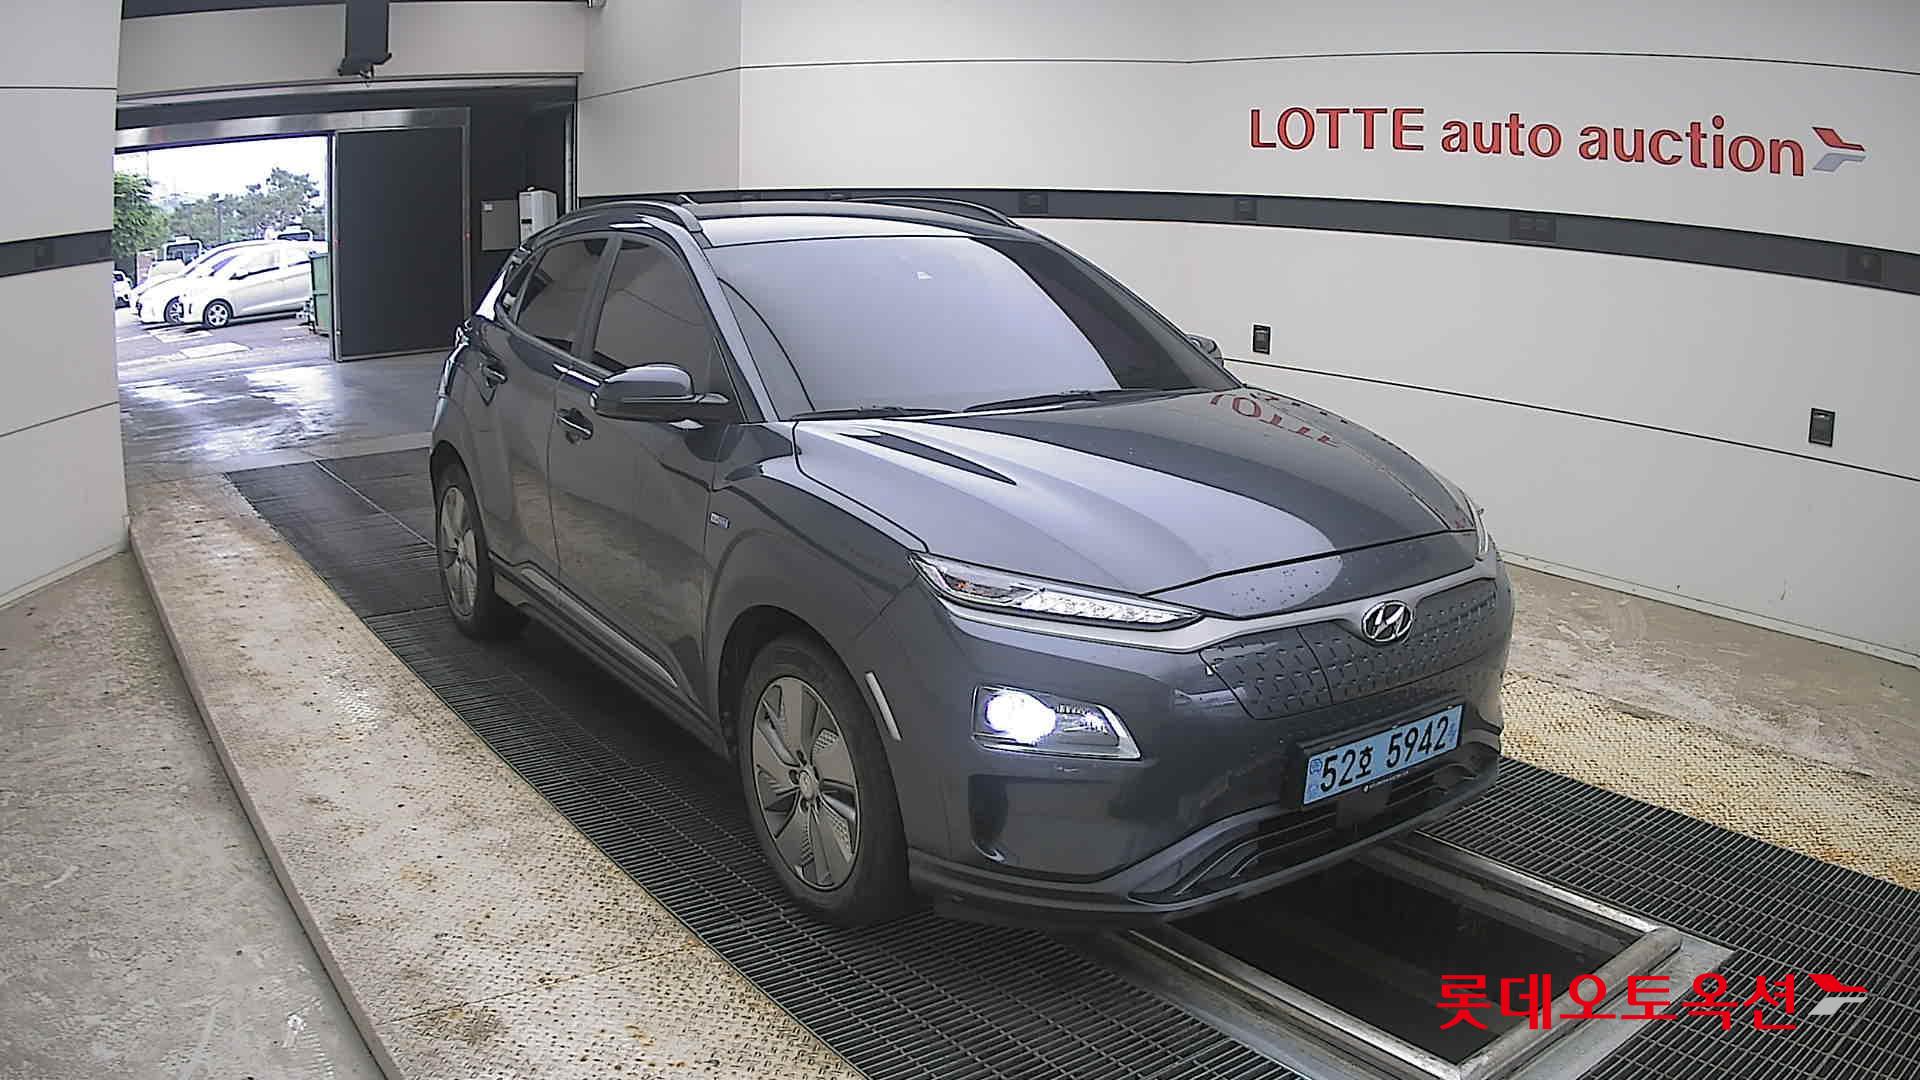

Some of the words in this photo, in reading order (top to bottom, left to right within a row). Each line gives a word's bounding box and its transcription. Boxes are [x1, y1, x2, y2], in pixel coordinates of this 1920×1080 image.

[1250, 107, 1425, 152] LOTTE
[1441, 112, 1562, 158] auto
[1578, 115, 1805, 177] auction
[1320, 746, 1374, 793] 52호
[1386, 716, 1449, 768] 5942
